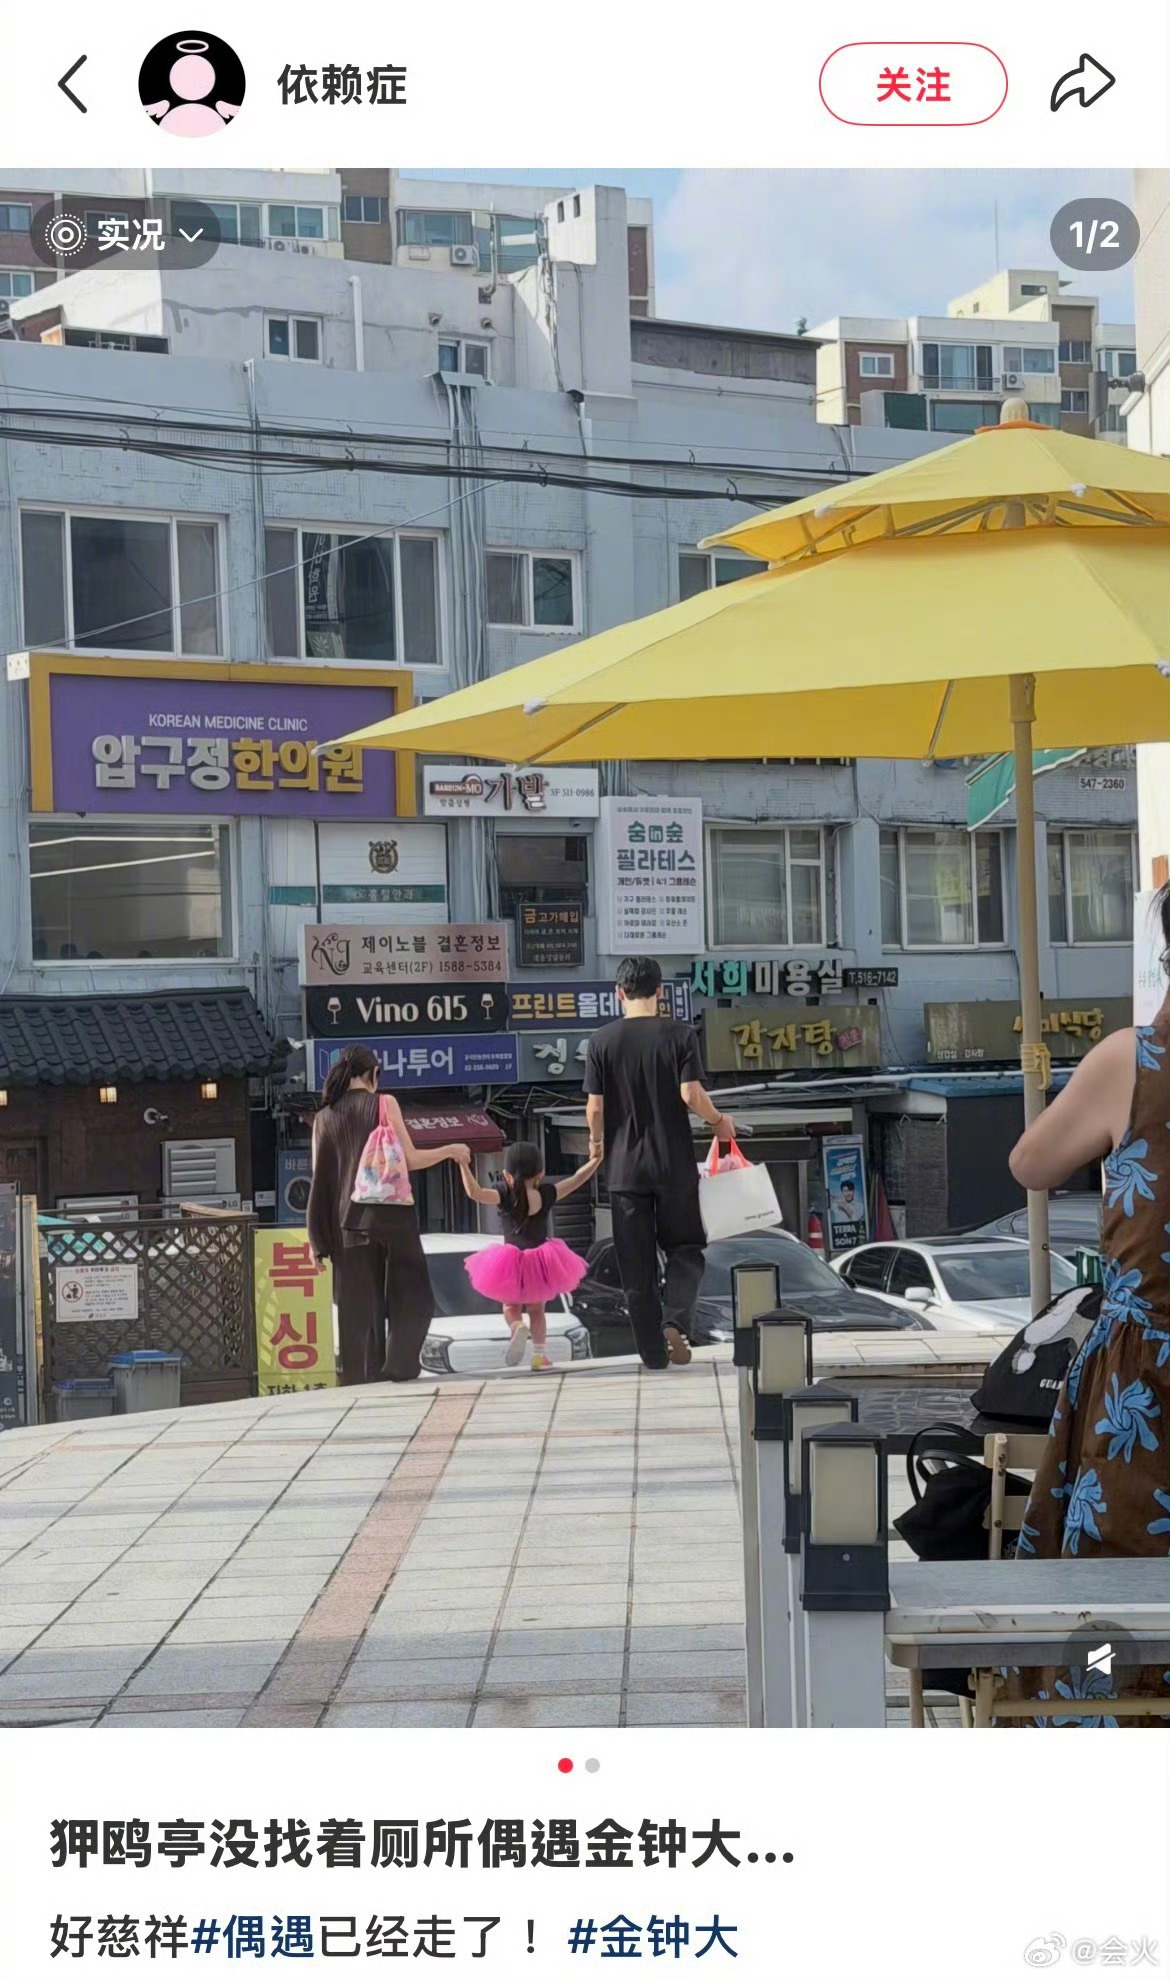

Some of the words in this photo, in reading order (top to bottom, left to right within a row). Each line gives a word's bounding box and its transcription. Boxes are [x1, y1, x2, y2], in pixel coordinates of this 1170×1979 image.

[149, 714, 200, 728] KOREAN
[205, 715, 265, 730] MEDICINE
[268, 717, 308, 732] CLINIC
[1080, 778, 1125, 790] 547-2360
[617, 848, 696, 871] 필라테스
[524, 909, 537, 923] 금
[361, 935, 427, 953] 제이노블
[437, 934, 501, 953] 결혼정보
[362, 961, 433, 975] 교육센터(2F)
[439, 960, 501, 973] 1588-5384
[690, 959, 844, 997] 서희미용실
[849, 971, 897, 985] T.516-7142
[355, 996, 419, 1023] Vino
[427, 995, 468, 1022] 615
[512, 992, 626, 1019] 프린트올데
[1013, 1008, 1104, 1041] 미식당
[731, 1019, 837, 1058] 감자탕
[376, 1046, 454, 1077] 나투어
[228, 1200, 239, 1208] LG
[268, 1242, 322, 1370] 복싱
